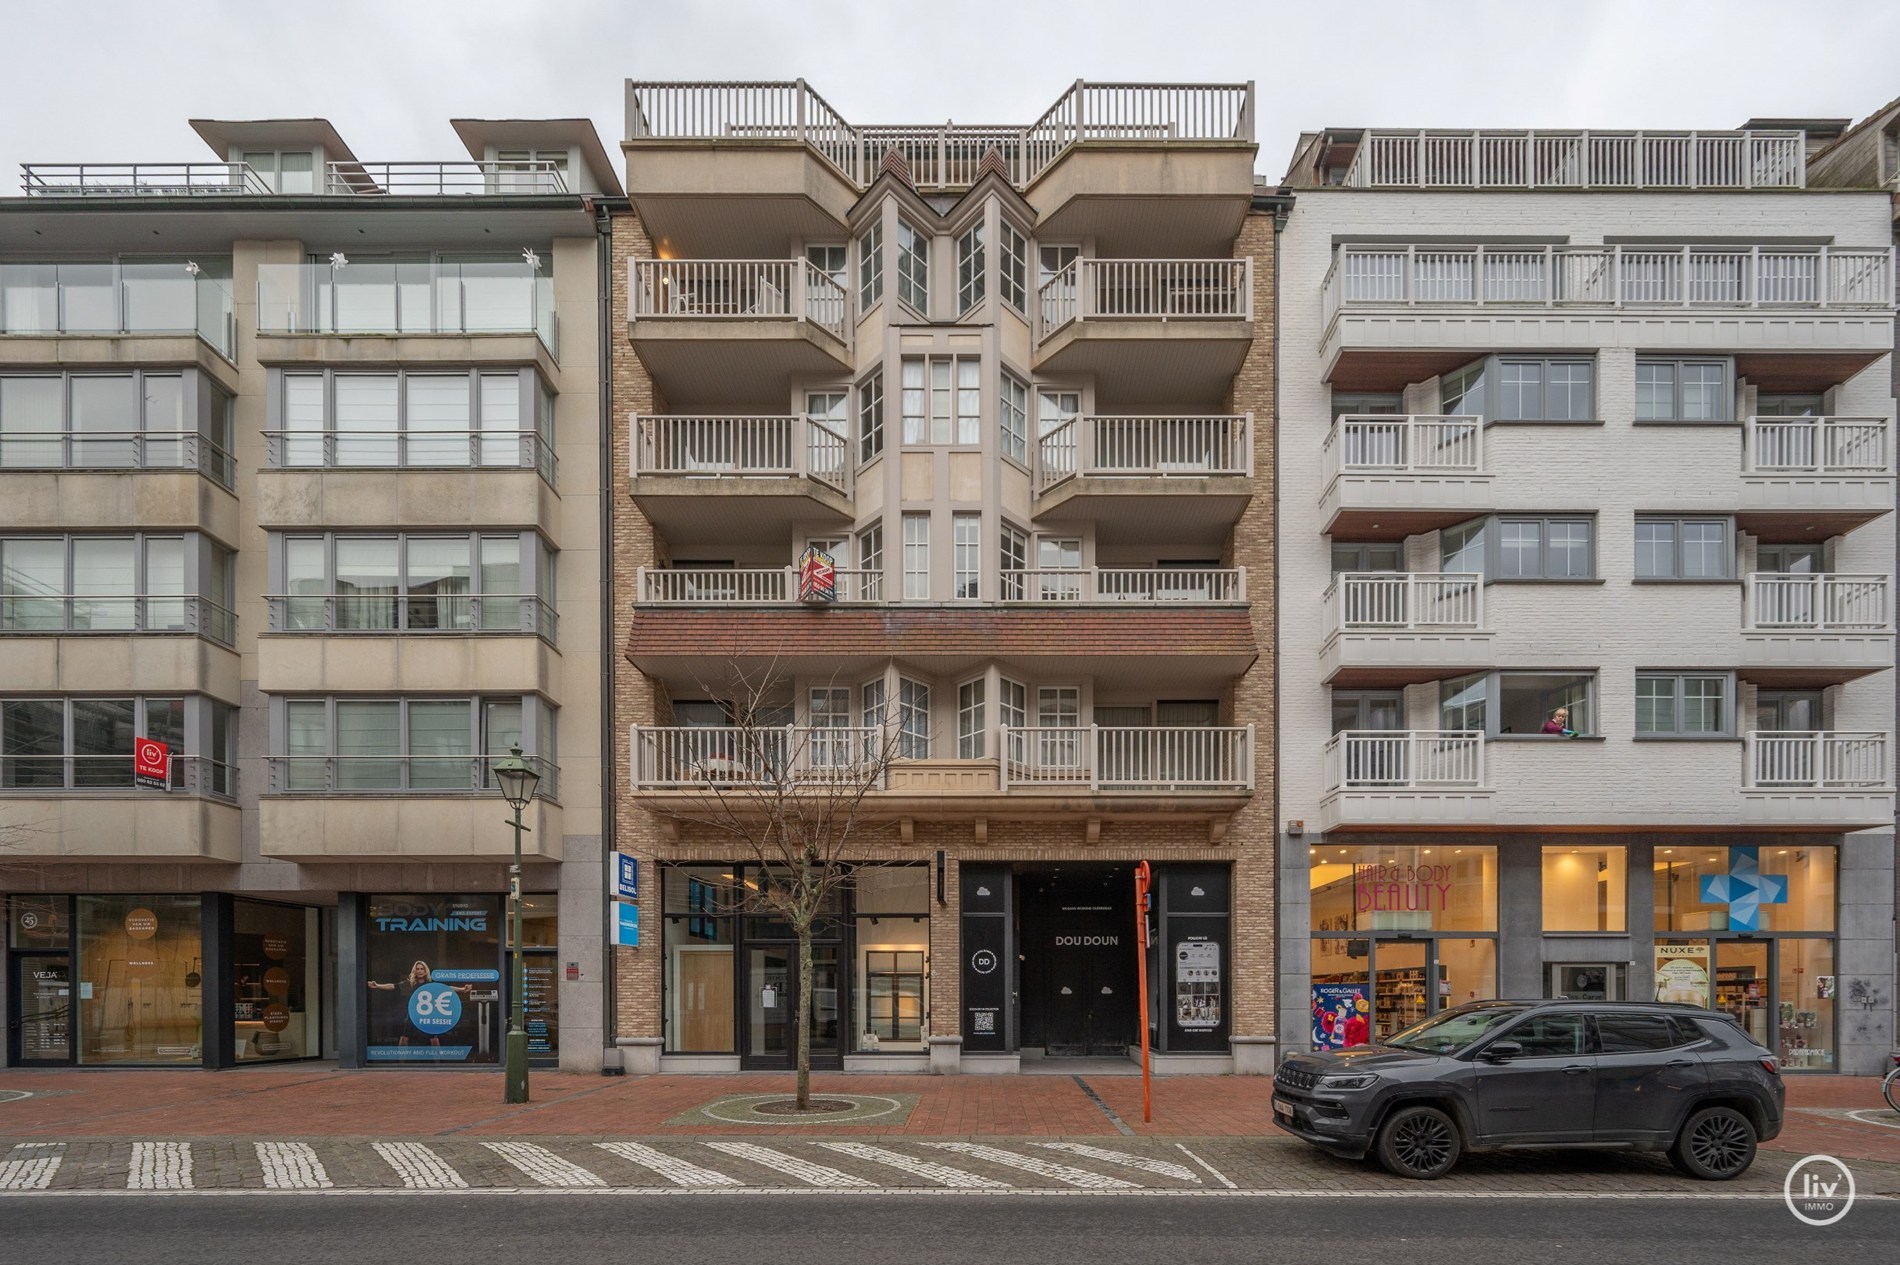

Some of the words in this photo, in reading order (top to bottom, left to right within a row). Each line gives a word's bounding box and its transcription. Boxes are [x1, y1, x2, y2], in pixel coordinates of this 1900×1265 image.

[1358, 864, 1386, 881] HAIR
[1408, 864, 1451, 881] BODY
[620, 884, 637, 894] BELISOL
[1358, 883, 1452, 911] BEAUTY
[378, 902, 444, 916] BODY
[24, 916, 34, 926] 25
[376, 918, 486, 932] TRAINING
[1056, 936, 1081, 946] DOU
[1084, 936, 1118, 946] DOUN
[416, 990, 453, 1015] 8€
